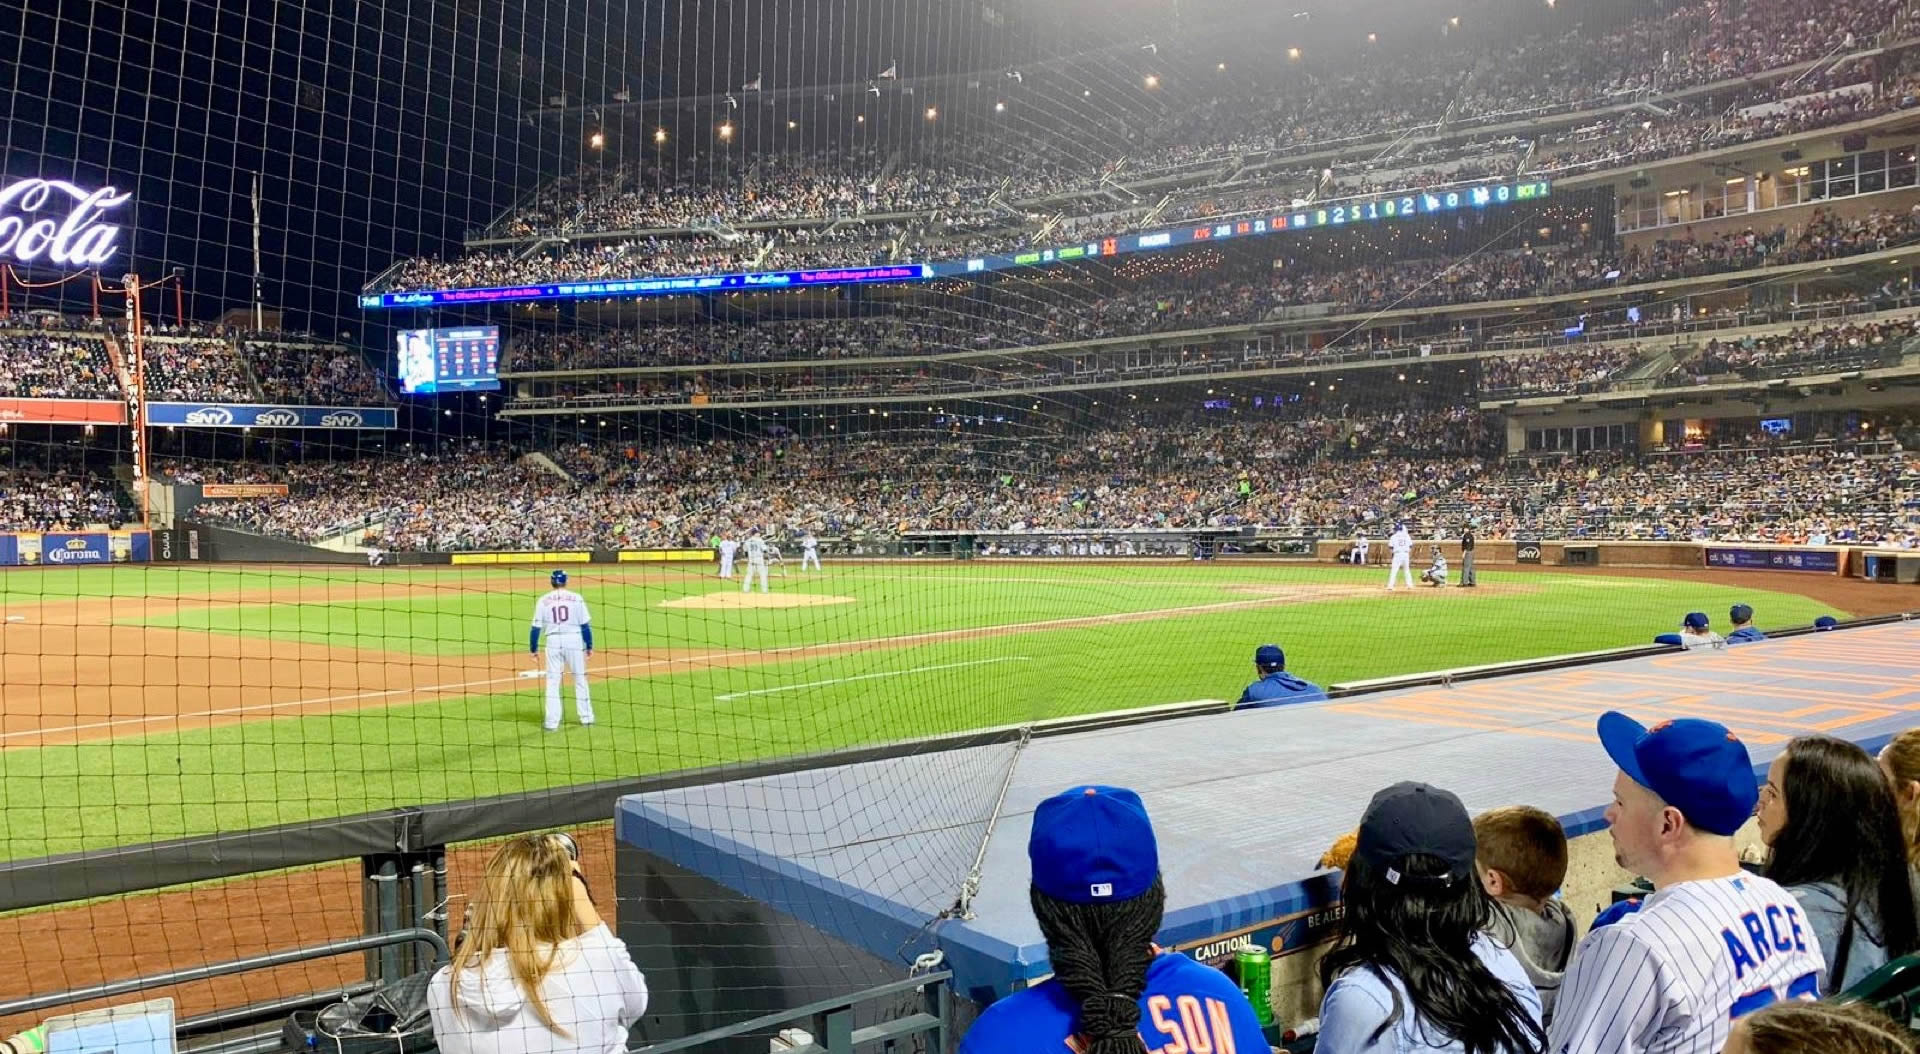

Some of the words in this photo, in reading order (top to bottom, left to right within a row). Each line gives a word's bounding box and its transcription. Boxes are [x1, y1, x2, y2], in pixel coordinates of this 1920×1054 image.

[1497, 186, 1509, 201] 0
[1516, 184, 1536, 198] BOT
[1540, 183, 1548, 195] 2
[1446, 192, 1458, 207] 0
[1332, 207, 1345, 224] 2
[1368, 203, 1378, 218] 1
[1401, 197, 1414, 214] 2
[48, 547, 101, 564] Corona
[552, 605, 569, 624] 10
[1307, 915, 1320, 929] BE
[1195, 934, 1251, 961] CAUTION!
[1720, 902, 1807, 980] ARCE
